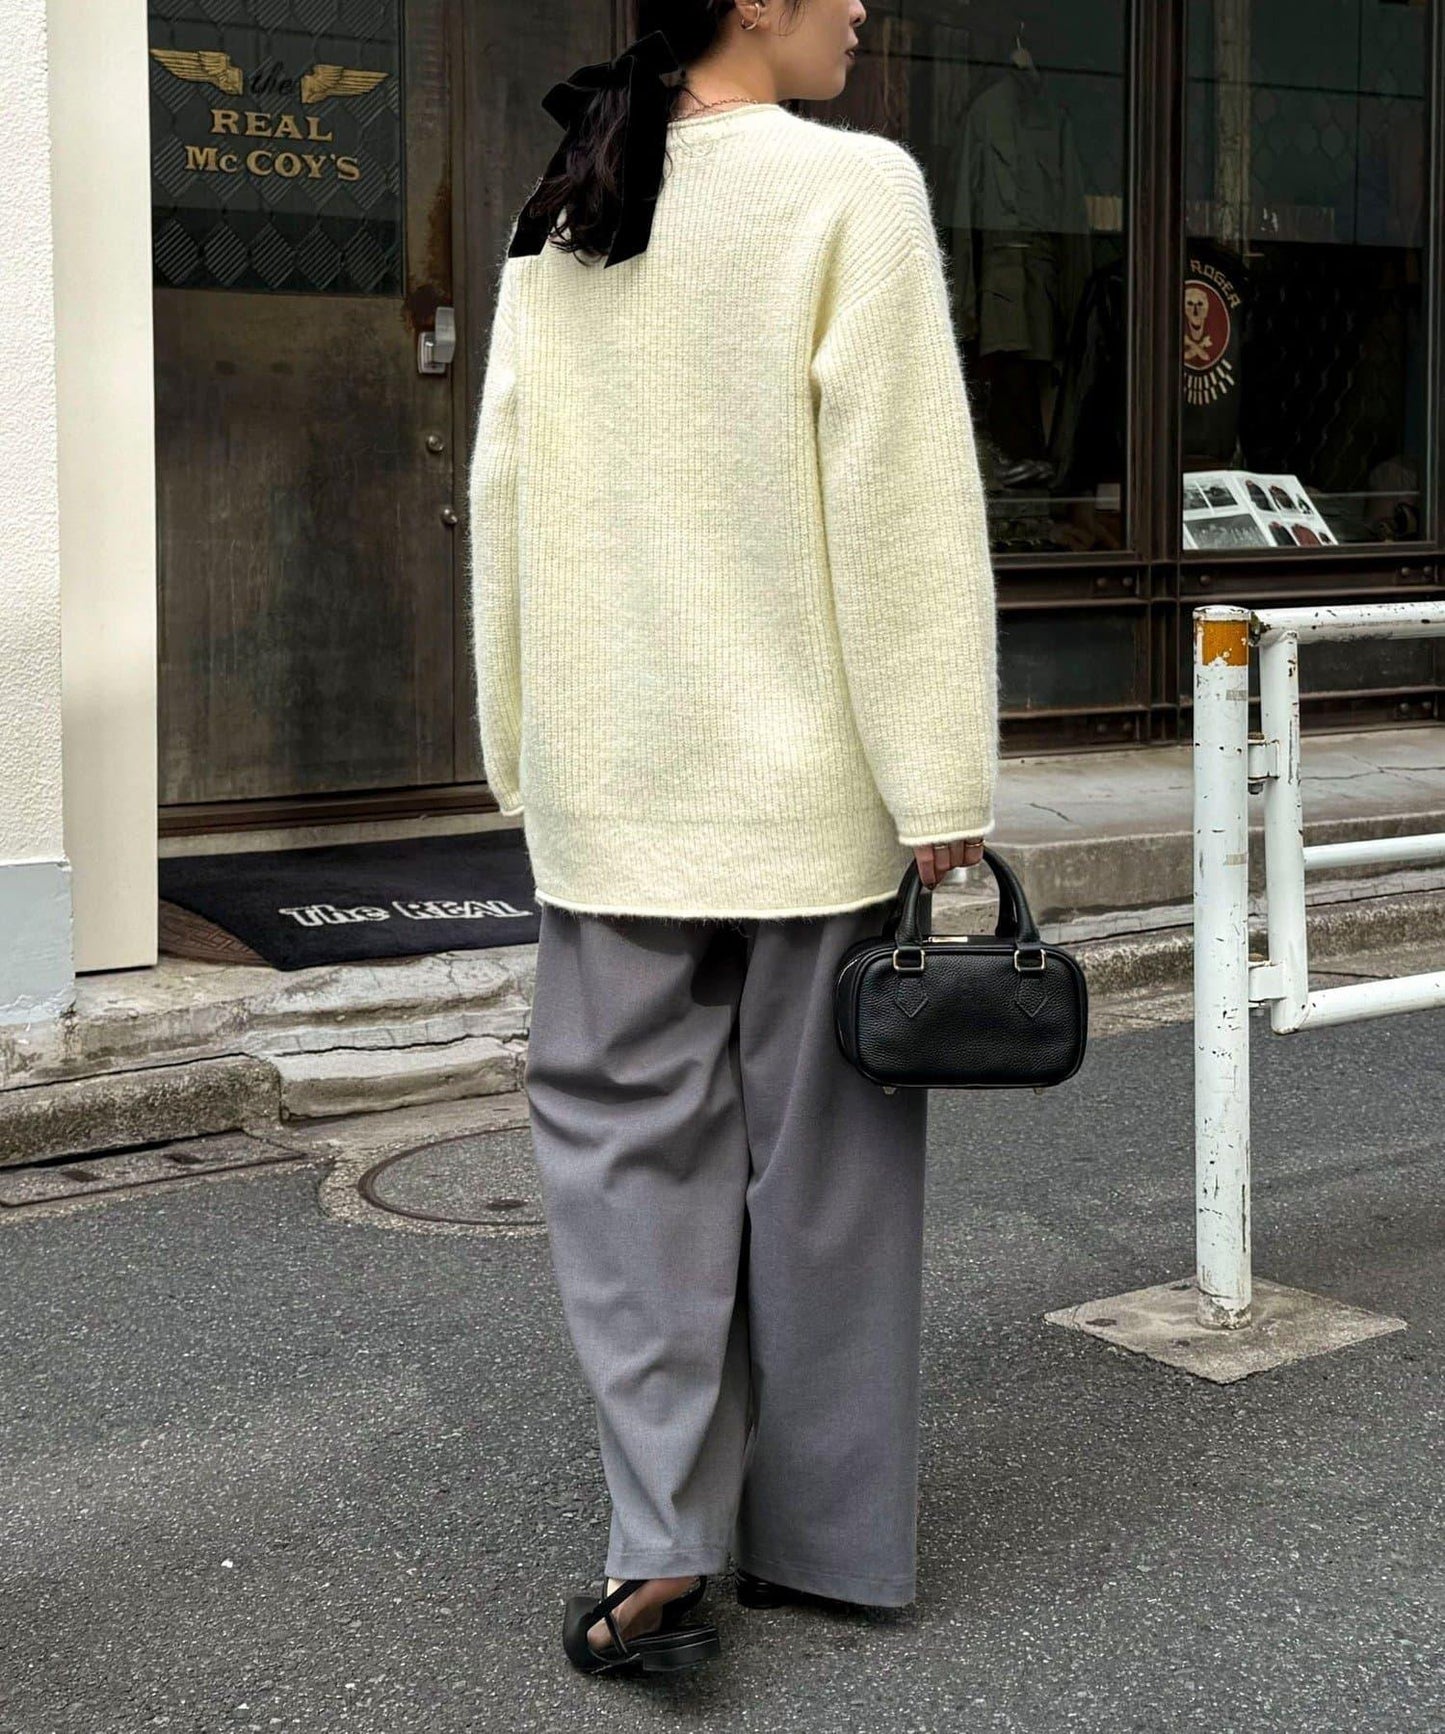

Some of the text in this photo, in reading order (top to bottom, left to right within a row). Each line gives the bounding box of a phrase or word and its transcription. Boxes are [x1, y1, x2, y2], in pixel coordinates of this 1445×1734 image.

[211, 108, 334, 141] REAL
[1190, 259, 1242, 308] ROGER
[279, 900, 533, 927] The REAL
